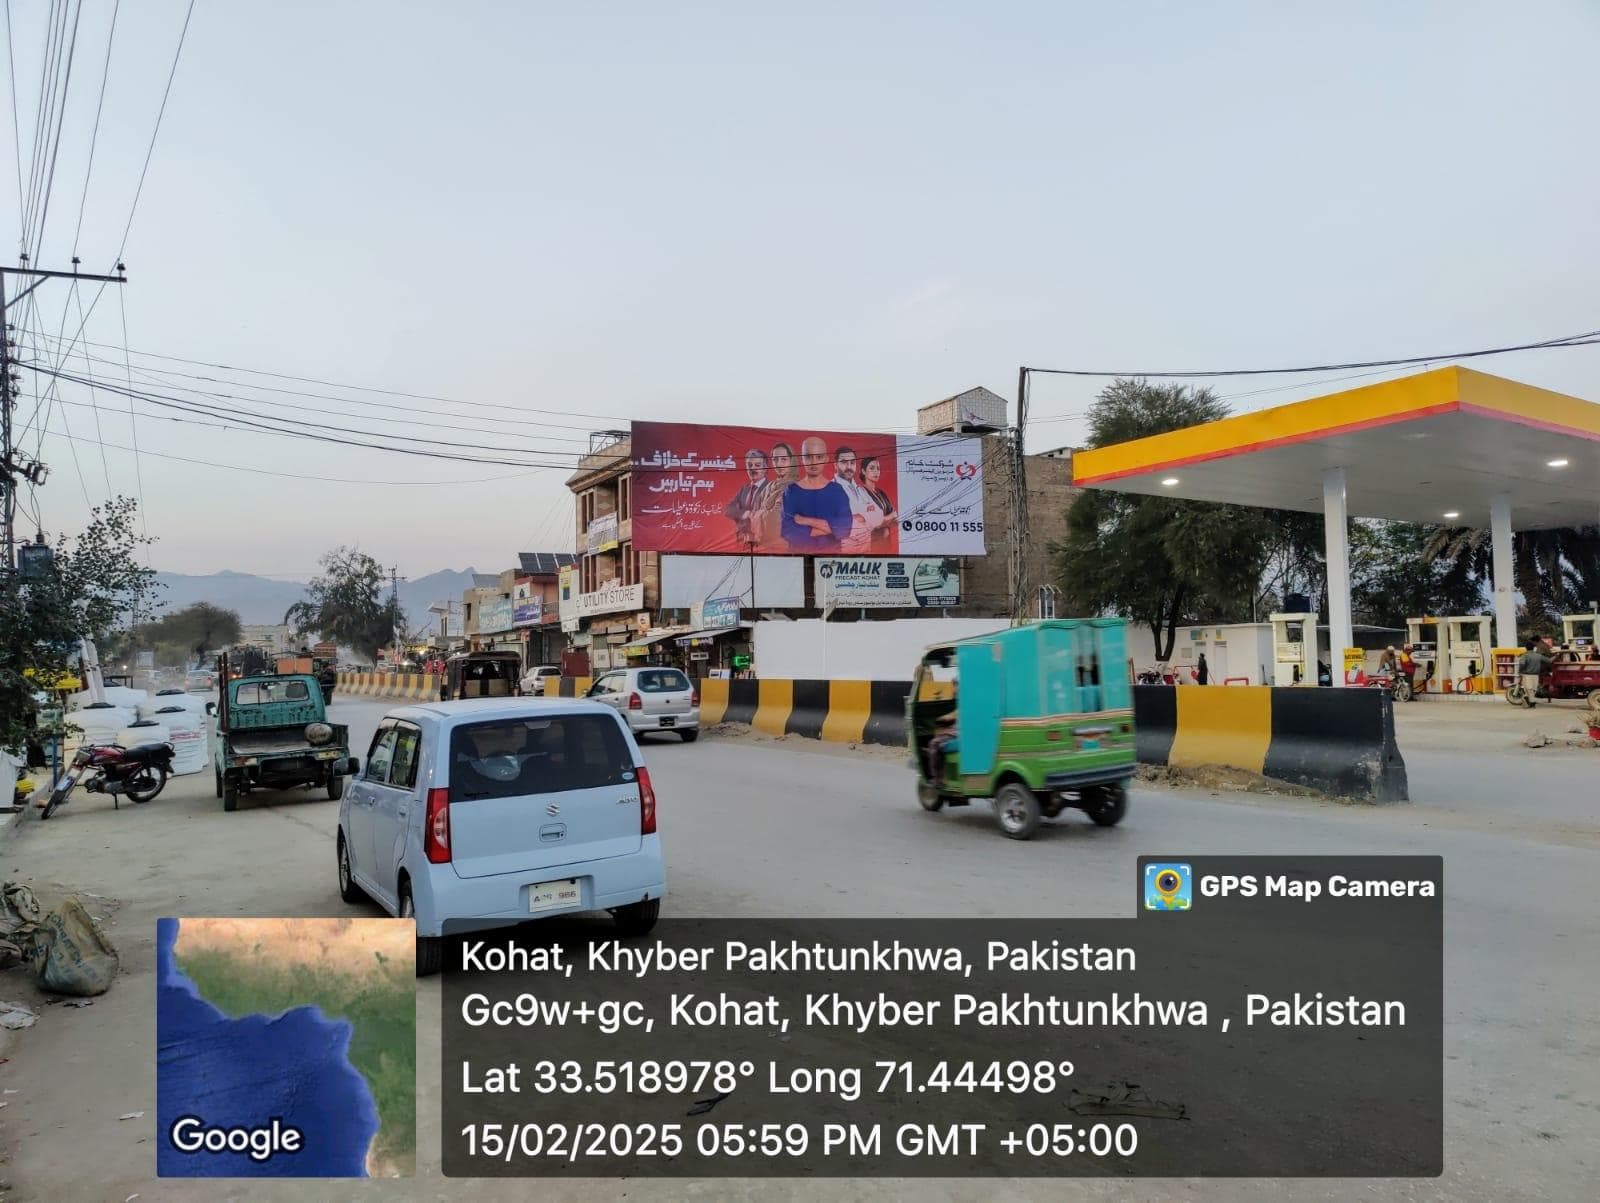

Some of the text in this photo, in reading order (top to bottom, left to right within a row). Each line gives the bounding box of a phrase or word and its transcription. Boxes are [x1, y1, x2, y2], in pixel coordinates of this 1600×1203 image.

[915, 521, 984, 533] 0800 11 555
[835, 561, 882, 575] MALIK
[583, 592, 608, 607] UTILITY
[609, 587, 635, 604] STORE
